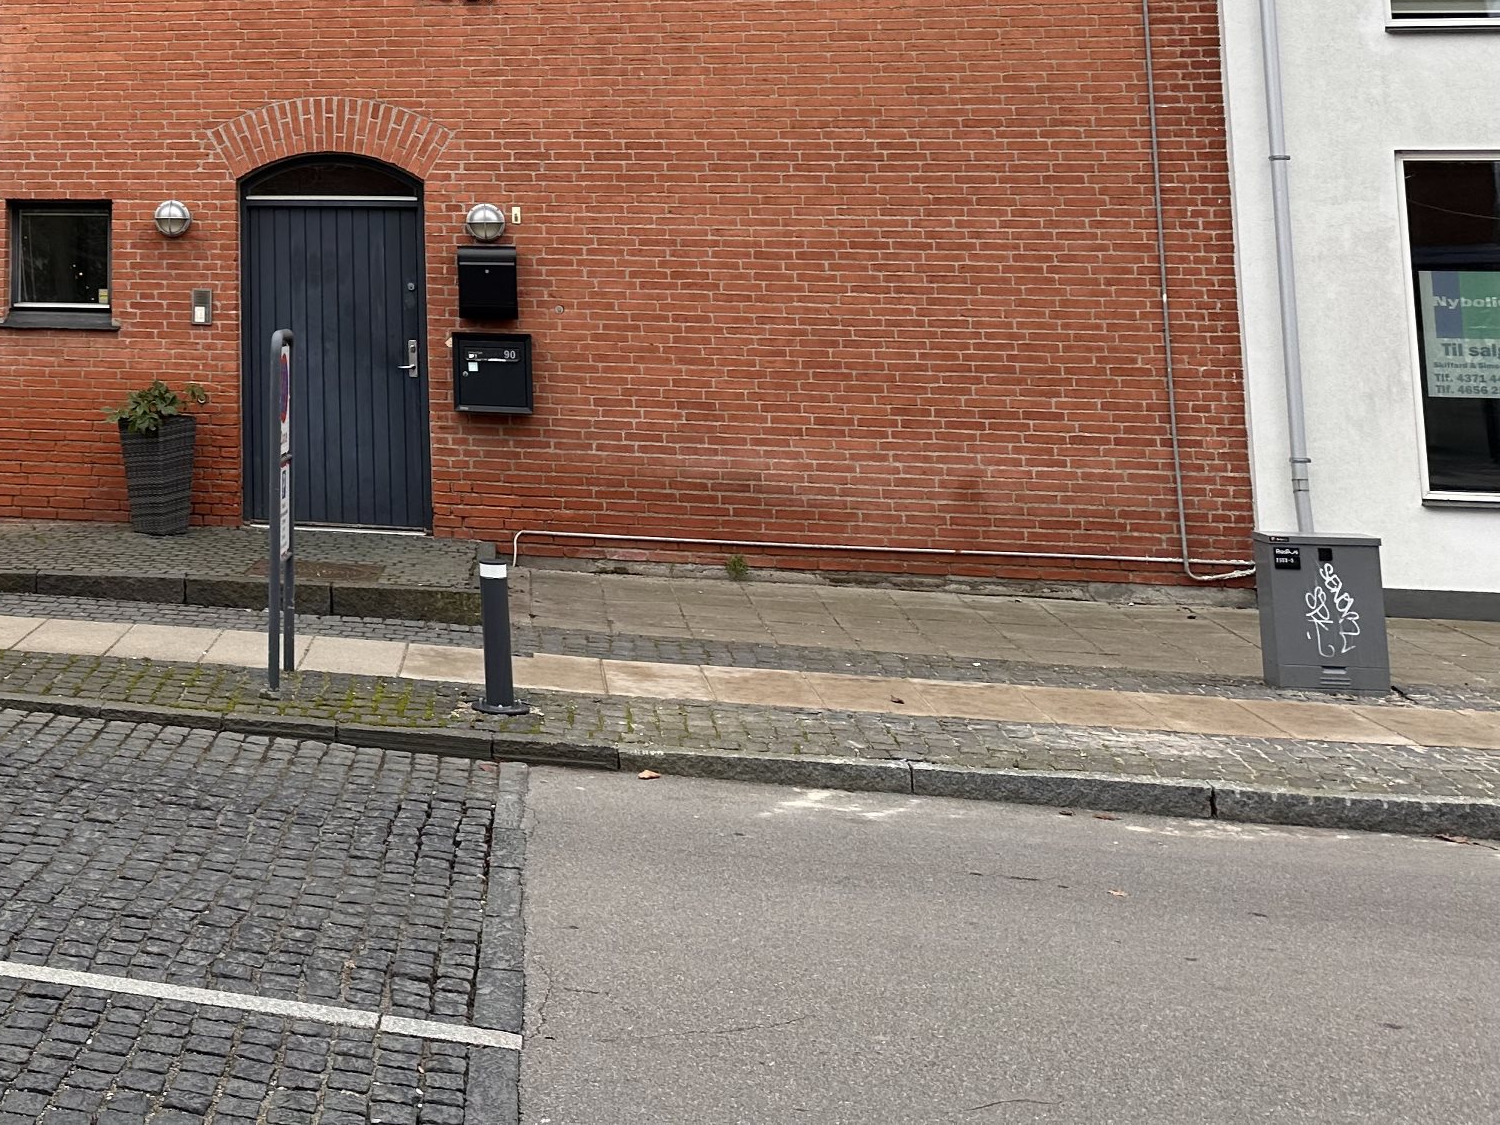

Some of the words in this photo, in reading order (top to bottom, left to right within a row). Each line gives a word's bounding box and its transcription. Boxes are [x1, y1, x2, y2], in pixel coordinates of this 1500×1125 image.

[1433, 296, 1500, 309] Nyboli
[1441, 343, 1463, 356] Til
[503, 350, 516, 359] 90
[1434, 374, 1453, 382] Tlf.
[1457, 374, 1487, 383] 4371
[1435, 385, 1455, 393] Tlf.
